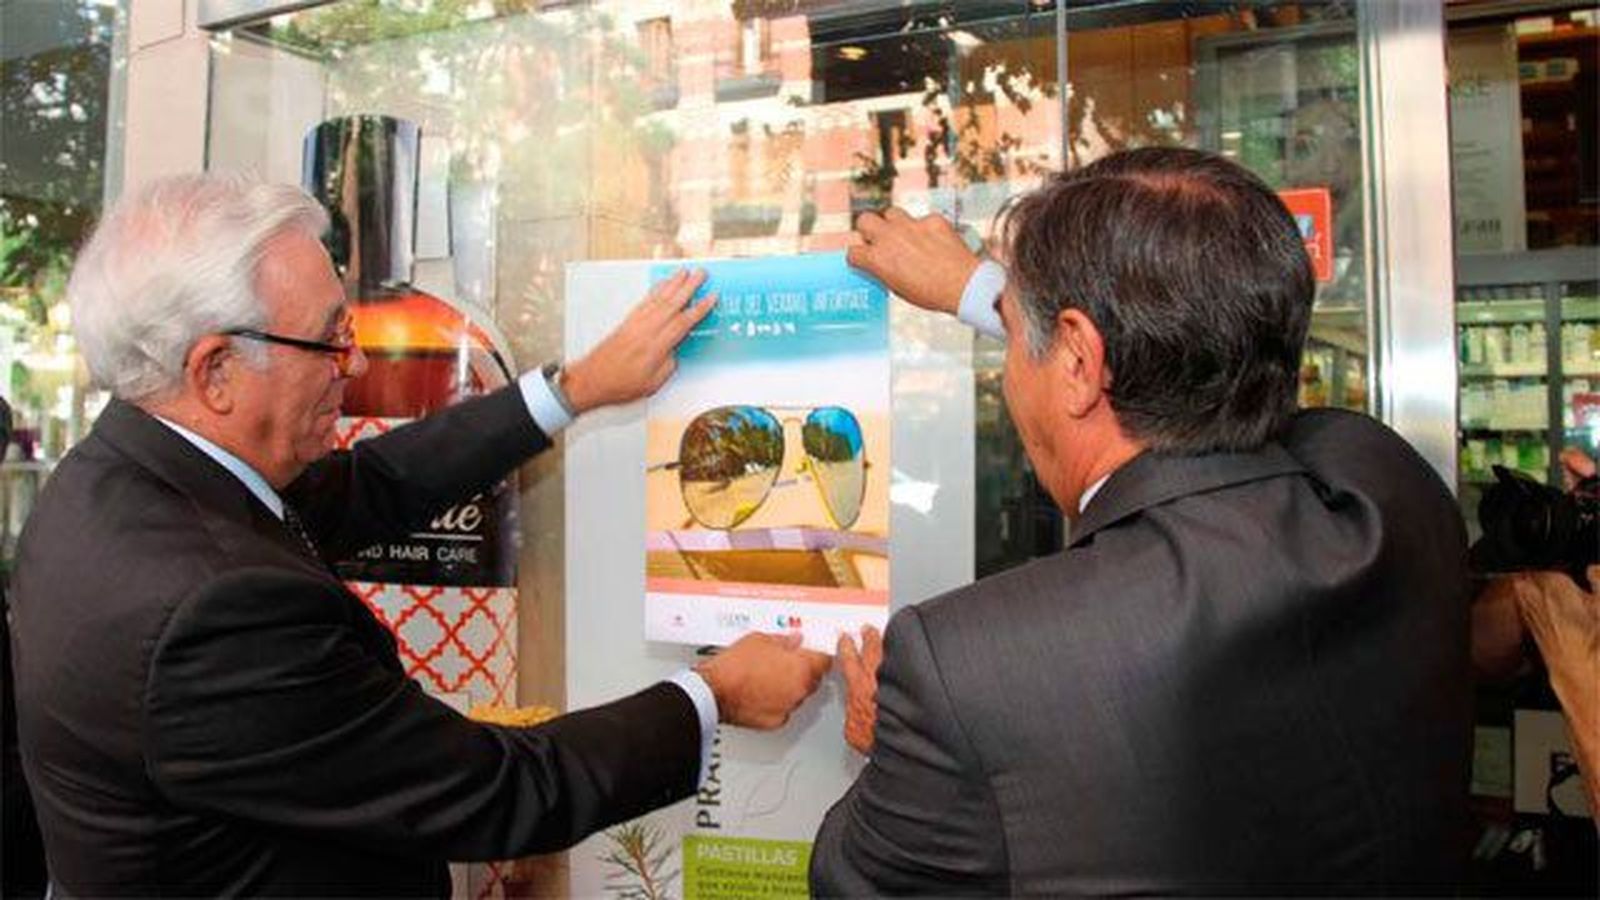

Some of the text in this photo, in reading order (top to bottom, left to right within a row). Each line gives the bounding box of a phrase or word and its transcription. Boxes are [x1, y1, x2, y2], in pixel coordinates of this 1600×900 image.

[389, 544, 430, 561] HAIR
[436, 546, 478, 564] CARE
[697, 842, 799, 866] PASTILLAS
